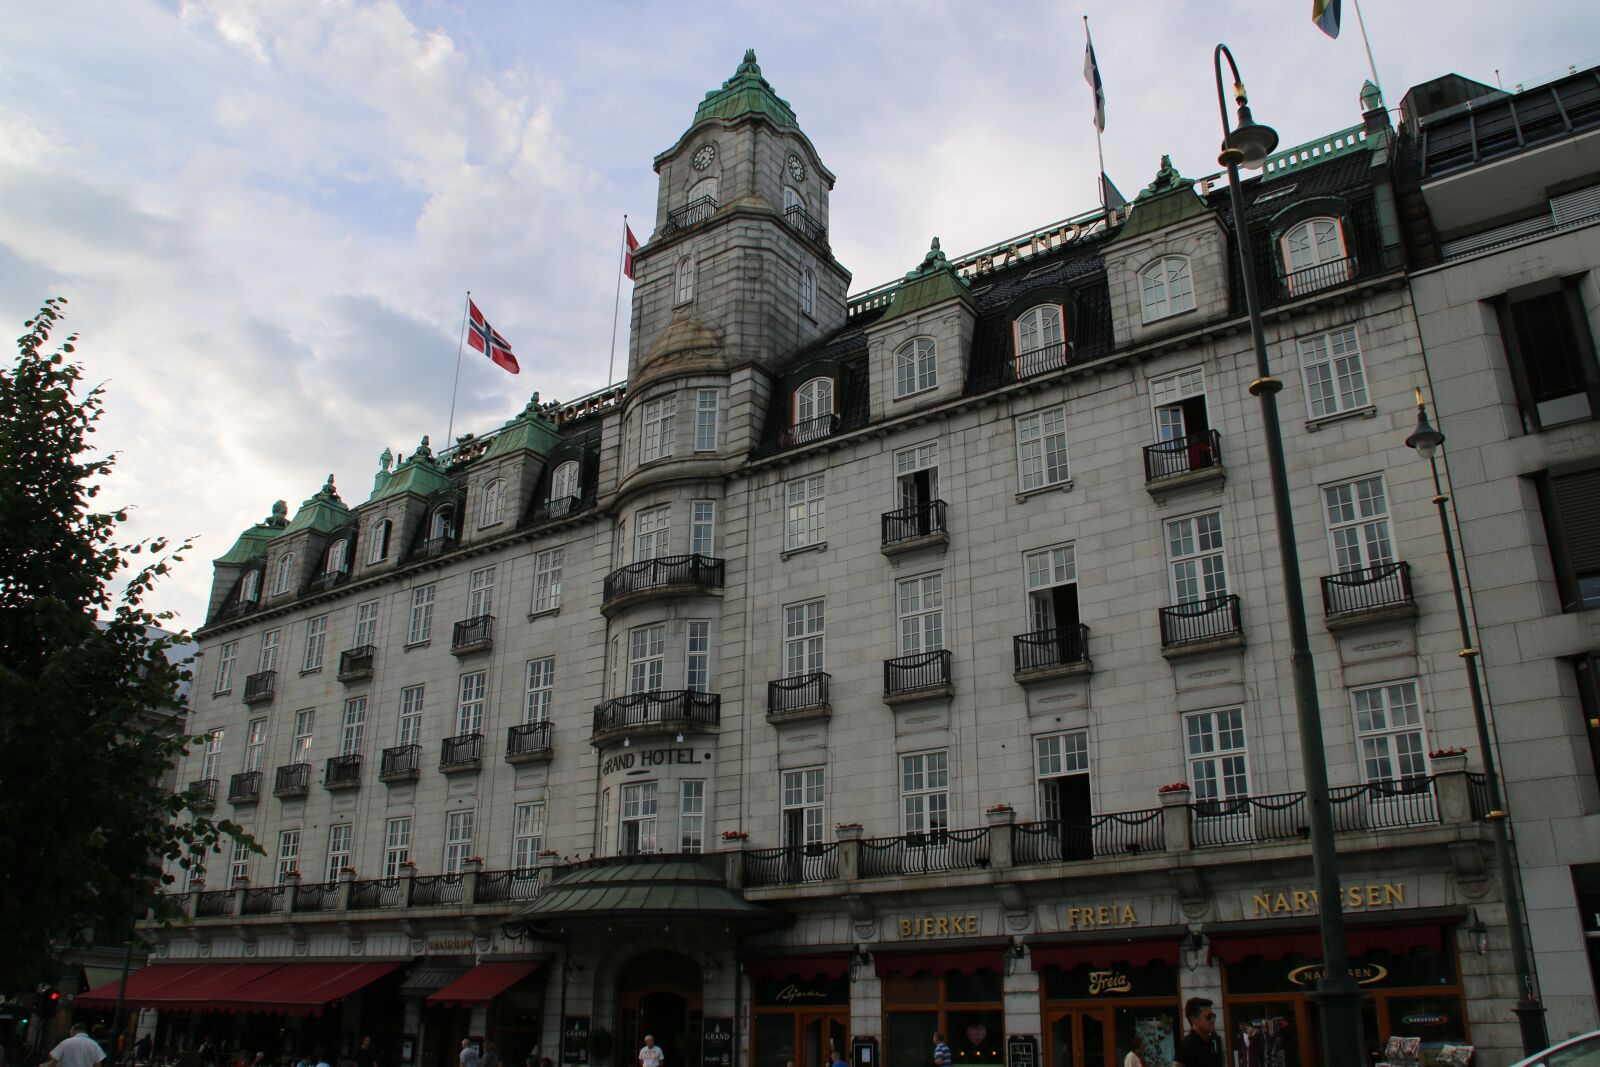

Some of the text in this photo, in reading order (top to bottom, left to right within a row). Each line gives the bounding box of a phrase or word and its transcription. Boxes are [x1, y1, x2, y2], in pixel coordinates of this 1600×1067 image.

[602, 748, 702, 776] GRAND HOTEL
[1253, 883, 1405, 914] NARSEN
[899, 915, 977, 936] BJERKE
[1067, 904, 1137, 928] FREIA
[1088, 970, 1132, 995] Freia
[705, 1033, 730, 1041] GRAND
